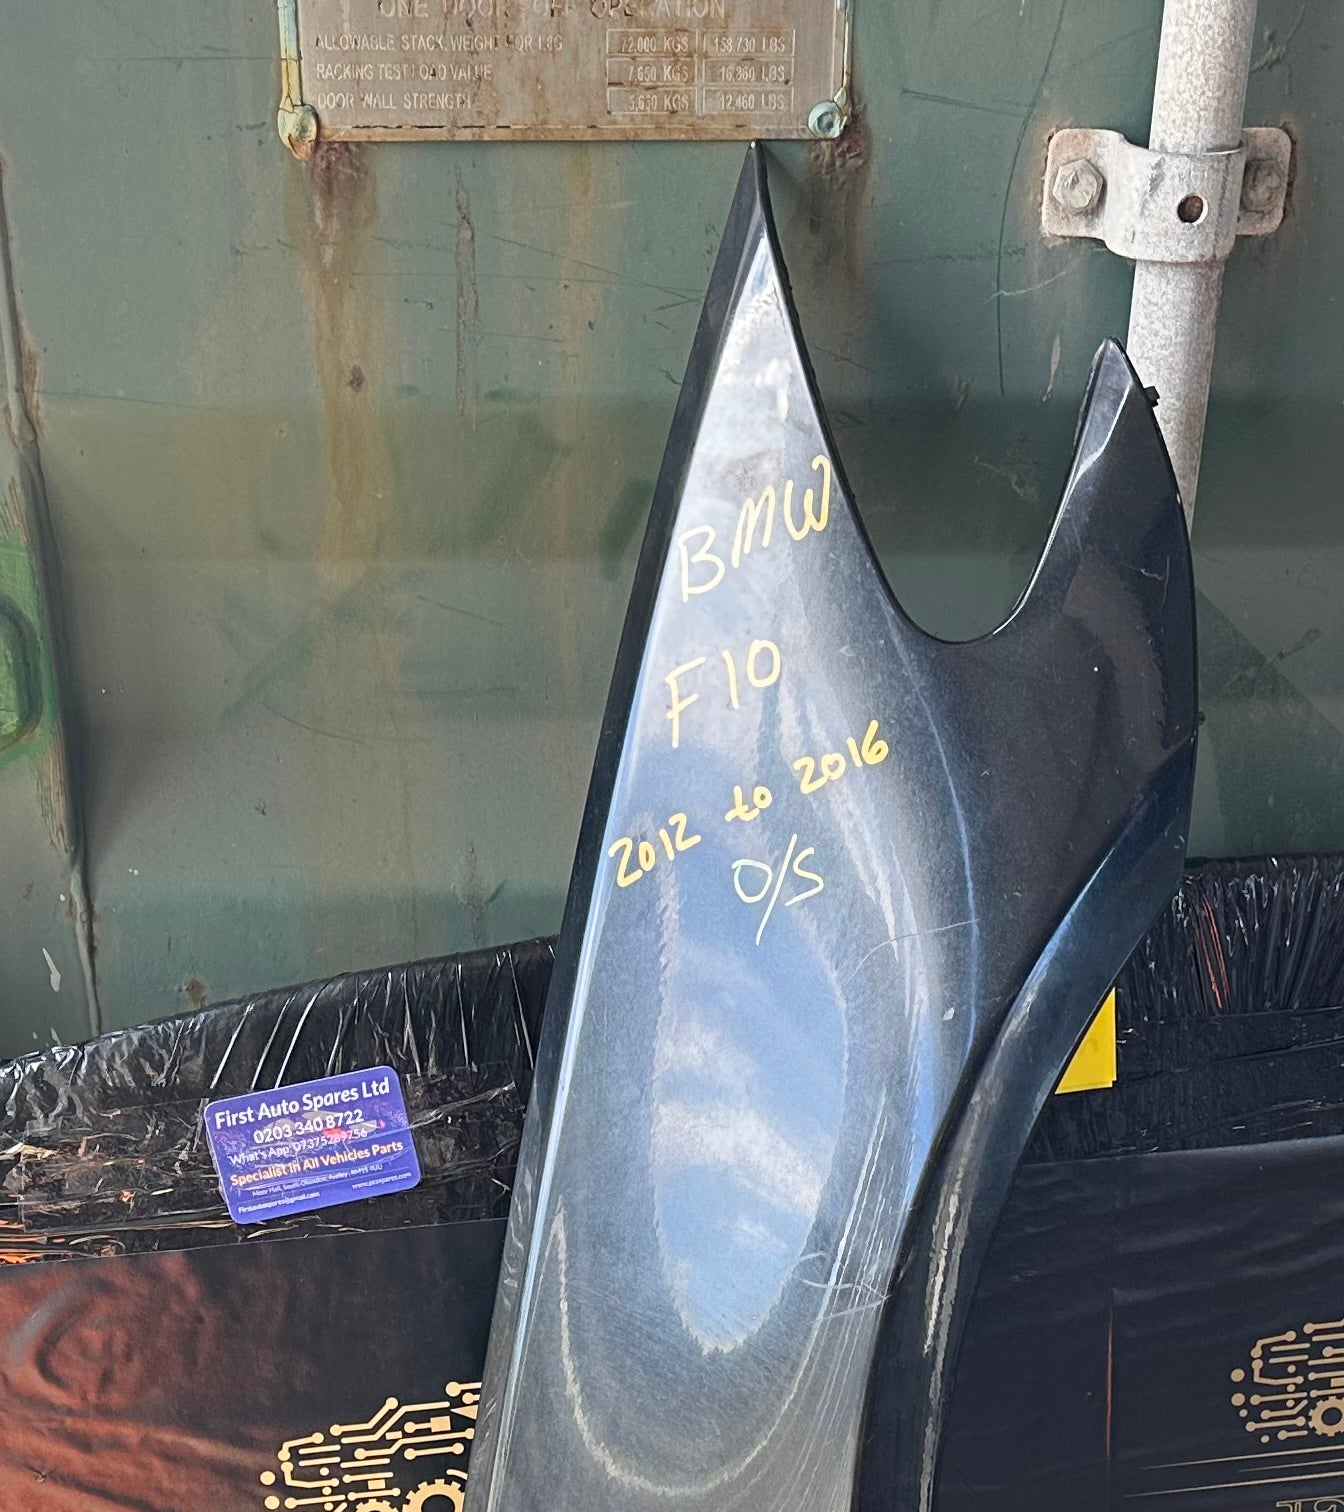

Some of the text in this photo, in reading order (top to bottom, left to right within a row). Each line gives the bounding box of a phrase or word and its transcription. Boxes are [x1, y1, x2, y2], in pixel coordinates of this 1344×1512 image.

[315, 34, 395, 51] ALLOWABLE
[450, 34, 499, 51] WEIGHT
[663, 37, 689, 53] KGS
[762, 37, 785, 53] LBS
[315, 63, 374, 81] RACKING
[379, 63, 408, 81] TEST
[411, 63, 448, 81] LOAD
[451, 63, 493, 81] VALUE
[663, 65, 689, 82] KGS
[762, 65, 785, 82] LBS
[317, 92, 355, 110] DOOR
[360, 92, 398, 110] WALL
[403, 92, 472, 110] STRENGTH
[663, 93, 689, 111] KGS
[719, 93, 756, 112] 12,460
[762, 93, 785, 111] LBS
[677, 454, 832, 602] BMW
[664, 639, 781, 748] F10
[607, 719, 890, 888] 2012 to 2016
[731, 833, 825, 945] O/S
[214, 1076, 390, 1130] First Auto Spares Ltd
[253, 1108, 365, 1144] 0203 340 8722
[229, 1149, 268, 1166] What's
[230, 1164, 288, 1187] Specialist
[302, 1157, 320, 1171] All
[320, 1147, 371, 1167] Vehicles
[371, 1140, 404, 1156] Parts
